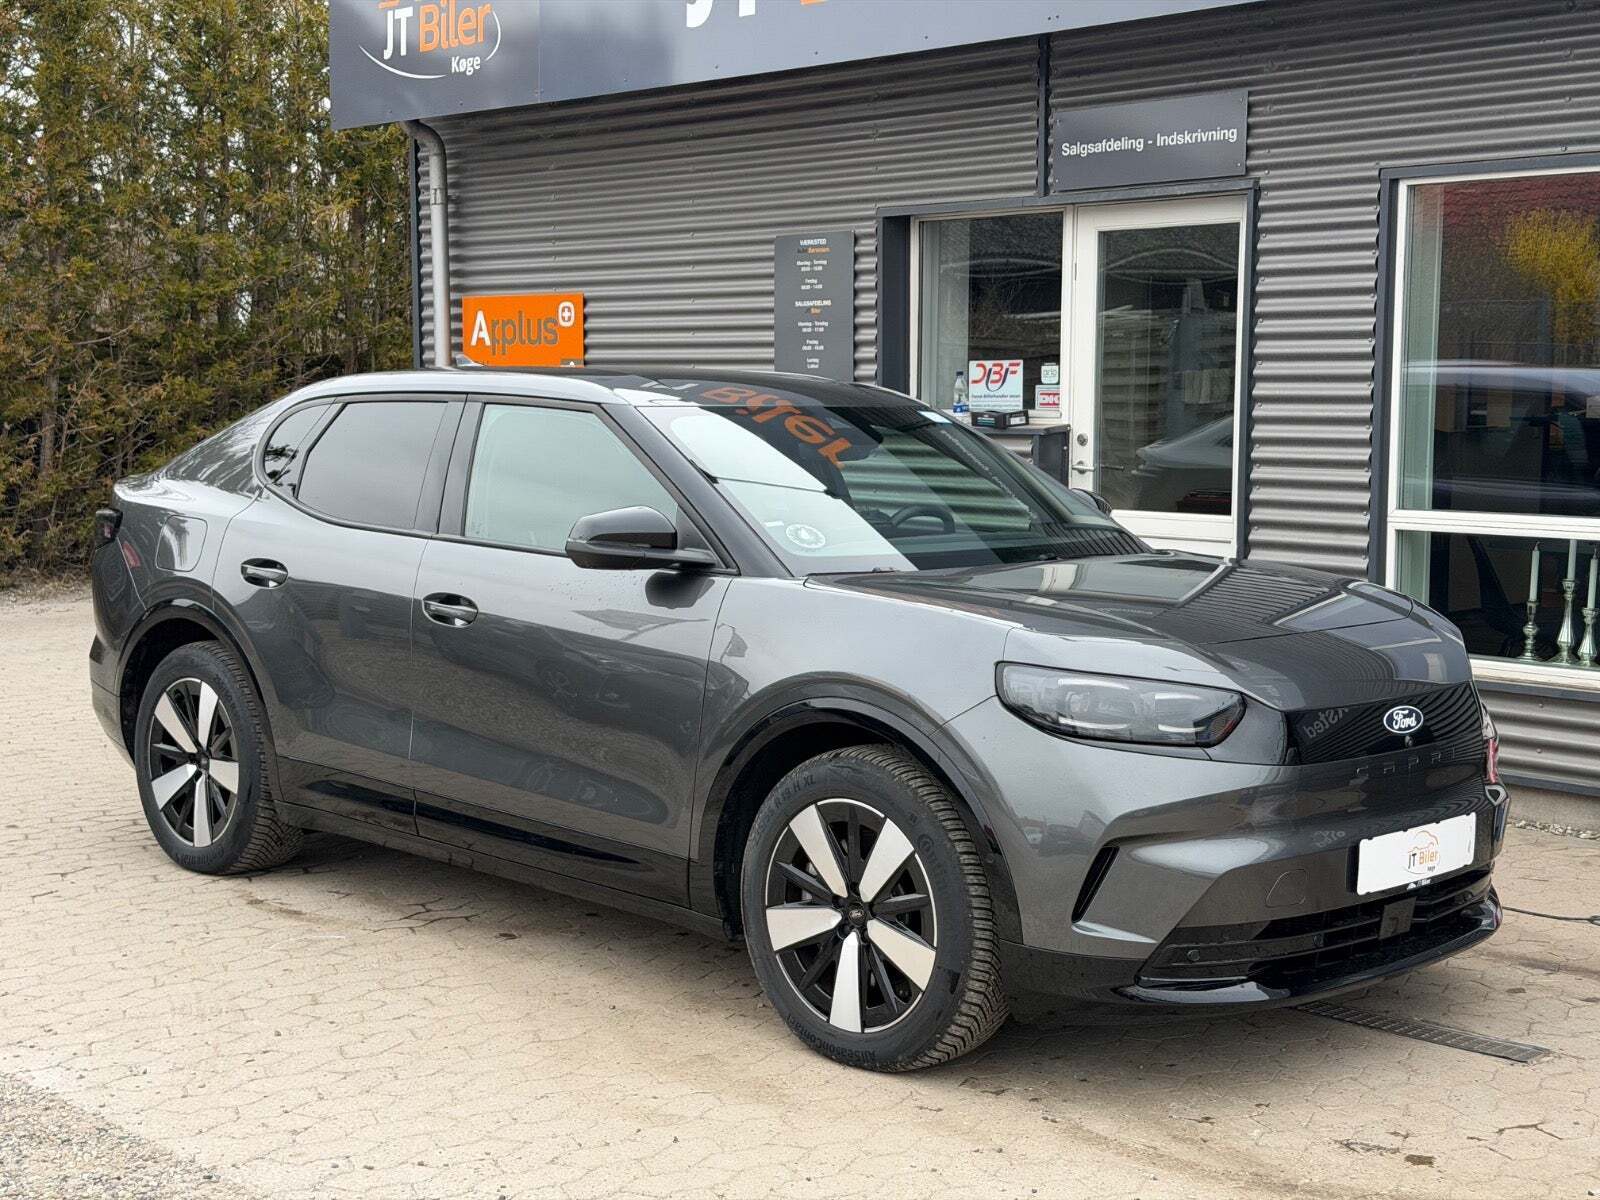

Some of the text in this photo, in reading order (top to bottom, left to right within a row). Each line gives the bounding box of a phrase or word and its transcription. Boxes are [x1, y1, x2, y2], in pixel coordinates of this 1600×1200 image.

[383, 0, 492, 60] JT Biler
[451, 56, 481, 76] Køge
[1061, 136, 1144, 157] Salgsafdeling
[1156, 127, 1238, 147] Indskrivning
[1393, 710, 1417, 730] Ford
[1408, 850, 1438, 869] JT Biler
